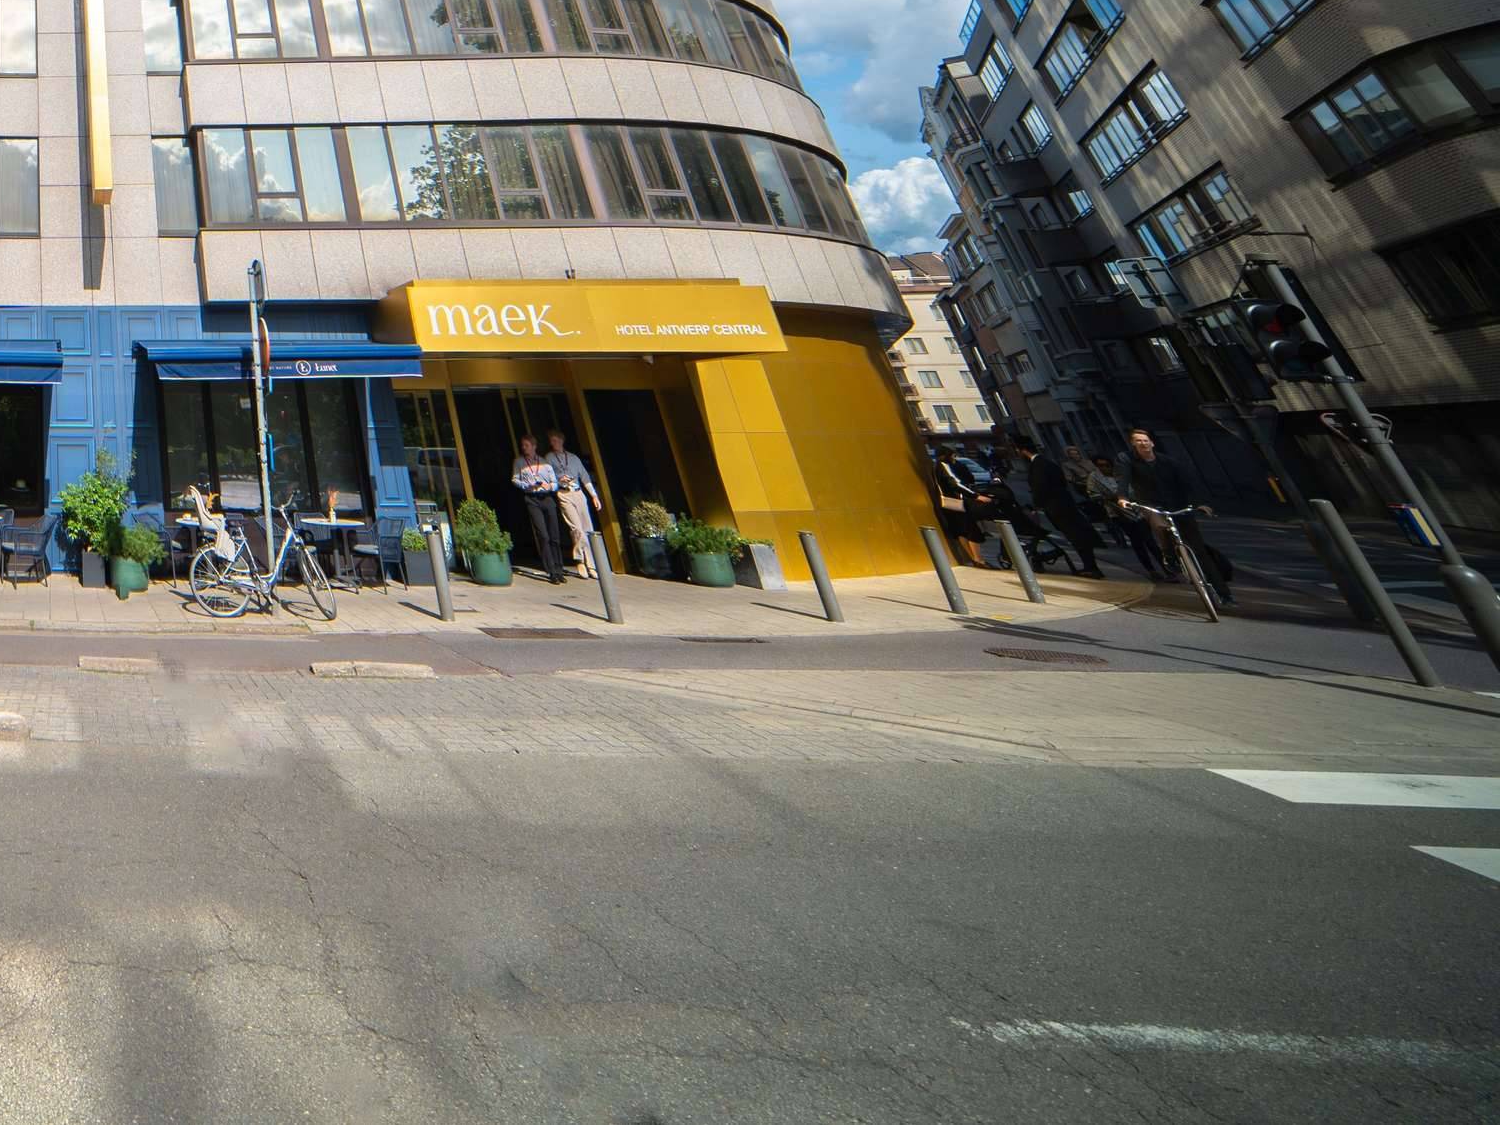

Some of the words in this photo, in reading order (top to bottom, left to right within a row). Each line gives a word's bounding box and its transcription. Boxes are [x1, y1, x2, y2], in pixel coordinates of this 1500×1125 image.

[614, 324, 654, 336] HOTEL
[656, 324, 710, 336] ANTWERP
[713, 324, 768, 336] CENTRAL
